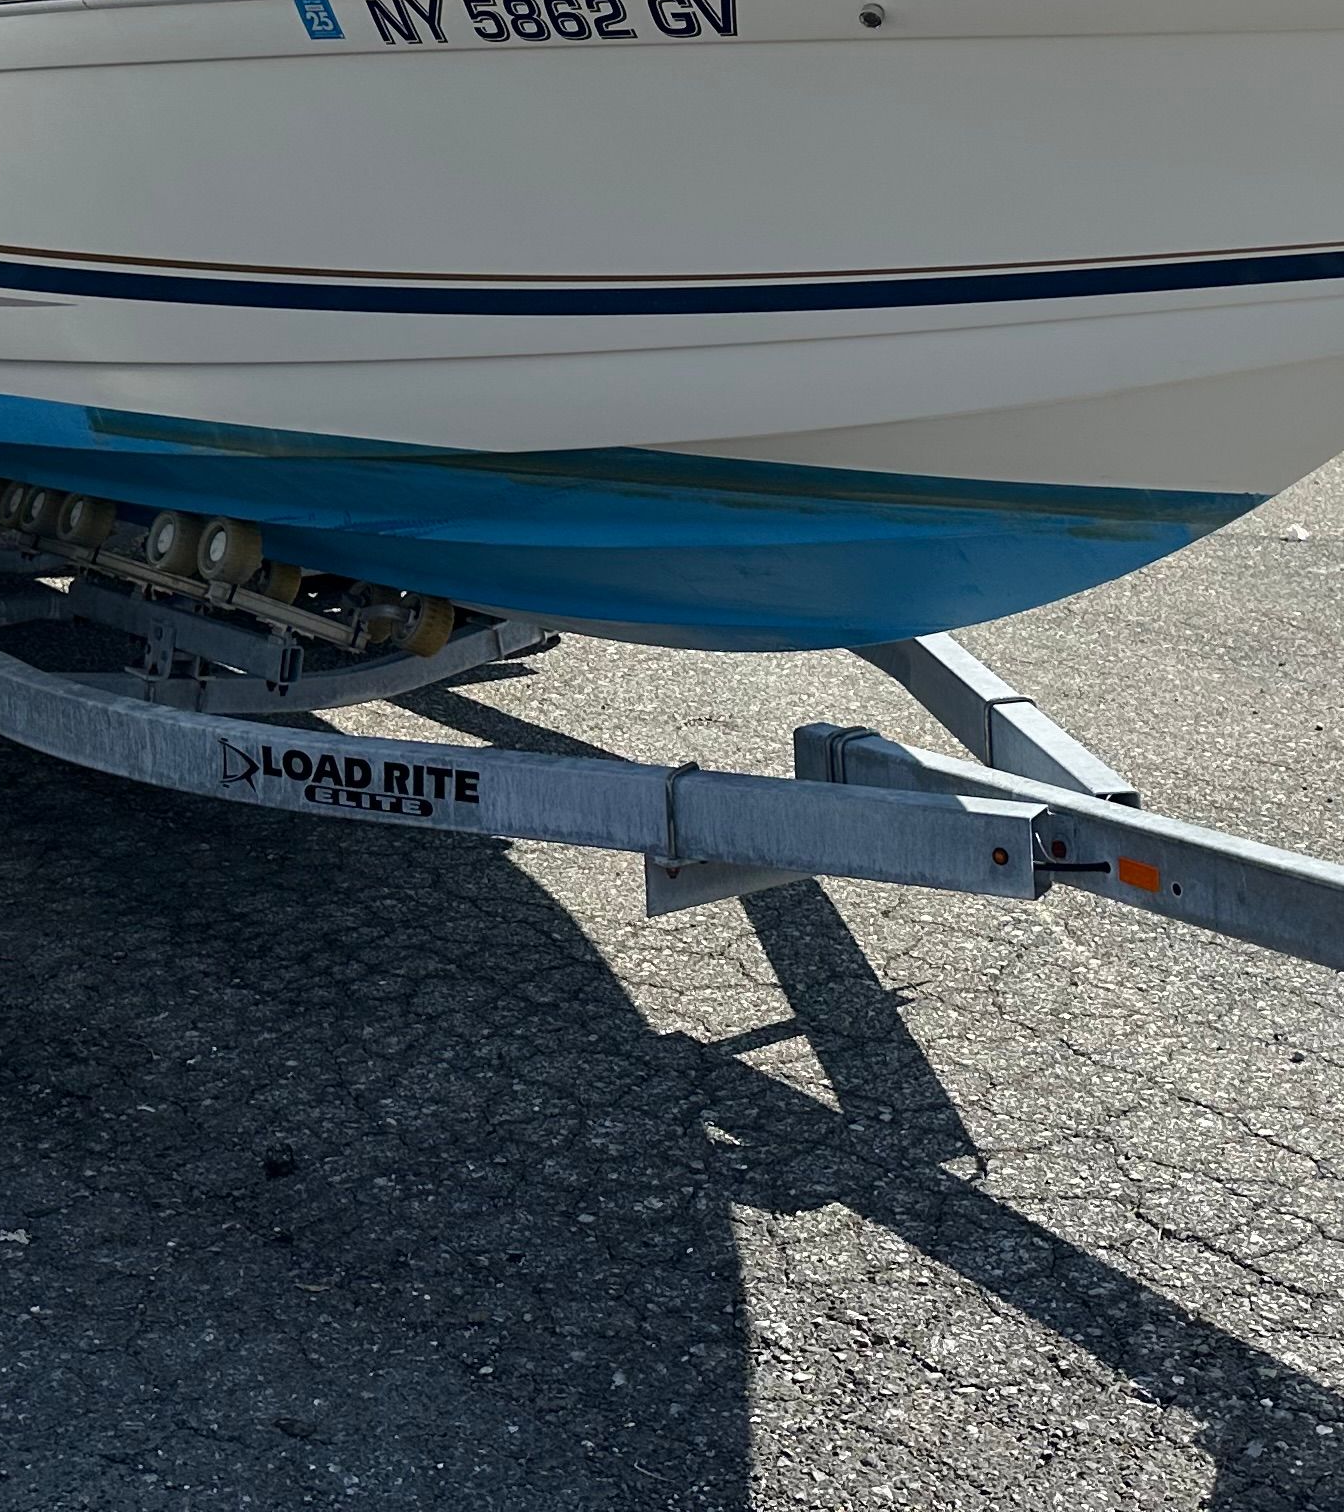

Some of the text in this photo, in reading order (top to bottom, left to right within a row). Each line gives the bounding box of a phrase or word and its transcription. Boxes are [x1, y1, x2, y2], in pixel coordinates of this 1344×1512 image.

[305, 11, 334, 31] 25
[261, 745, 480, 804] LOAD RITE
[314, 787, 423, 816] ELITE
